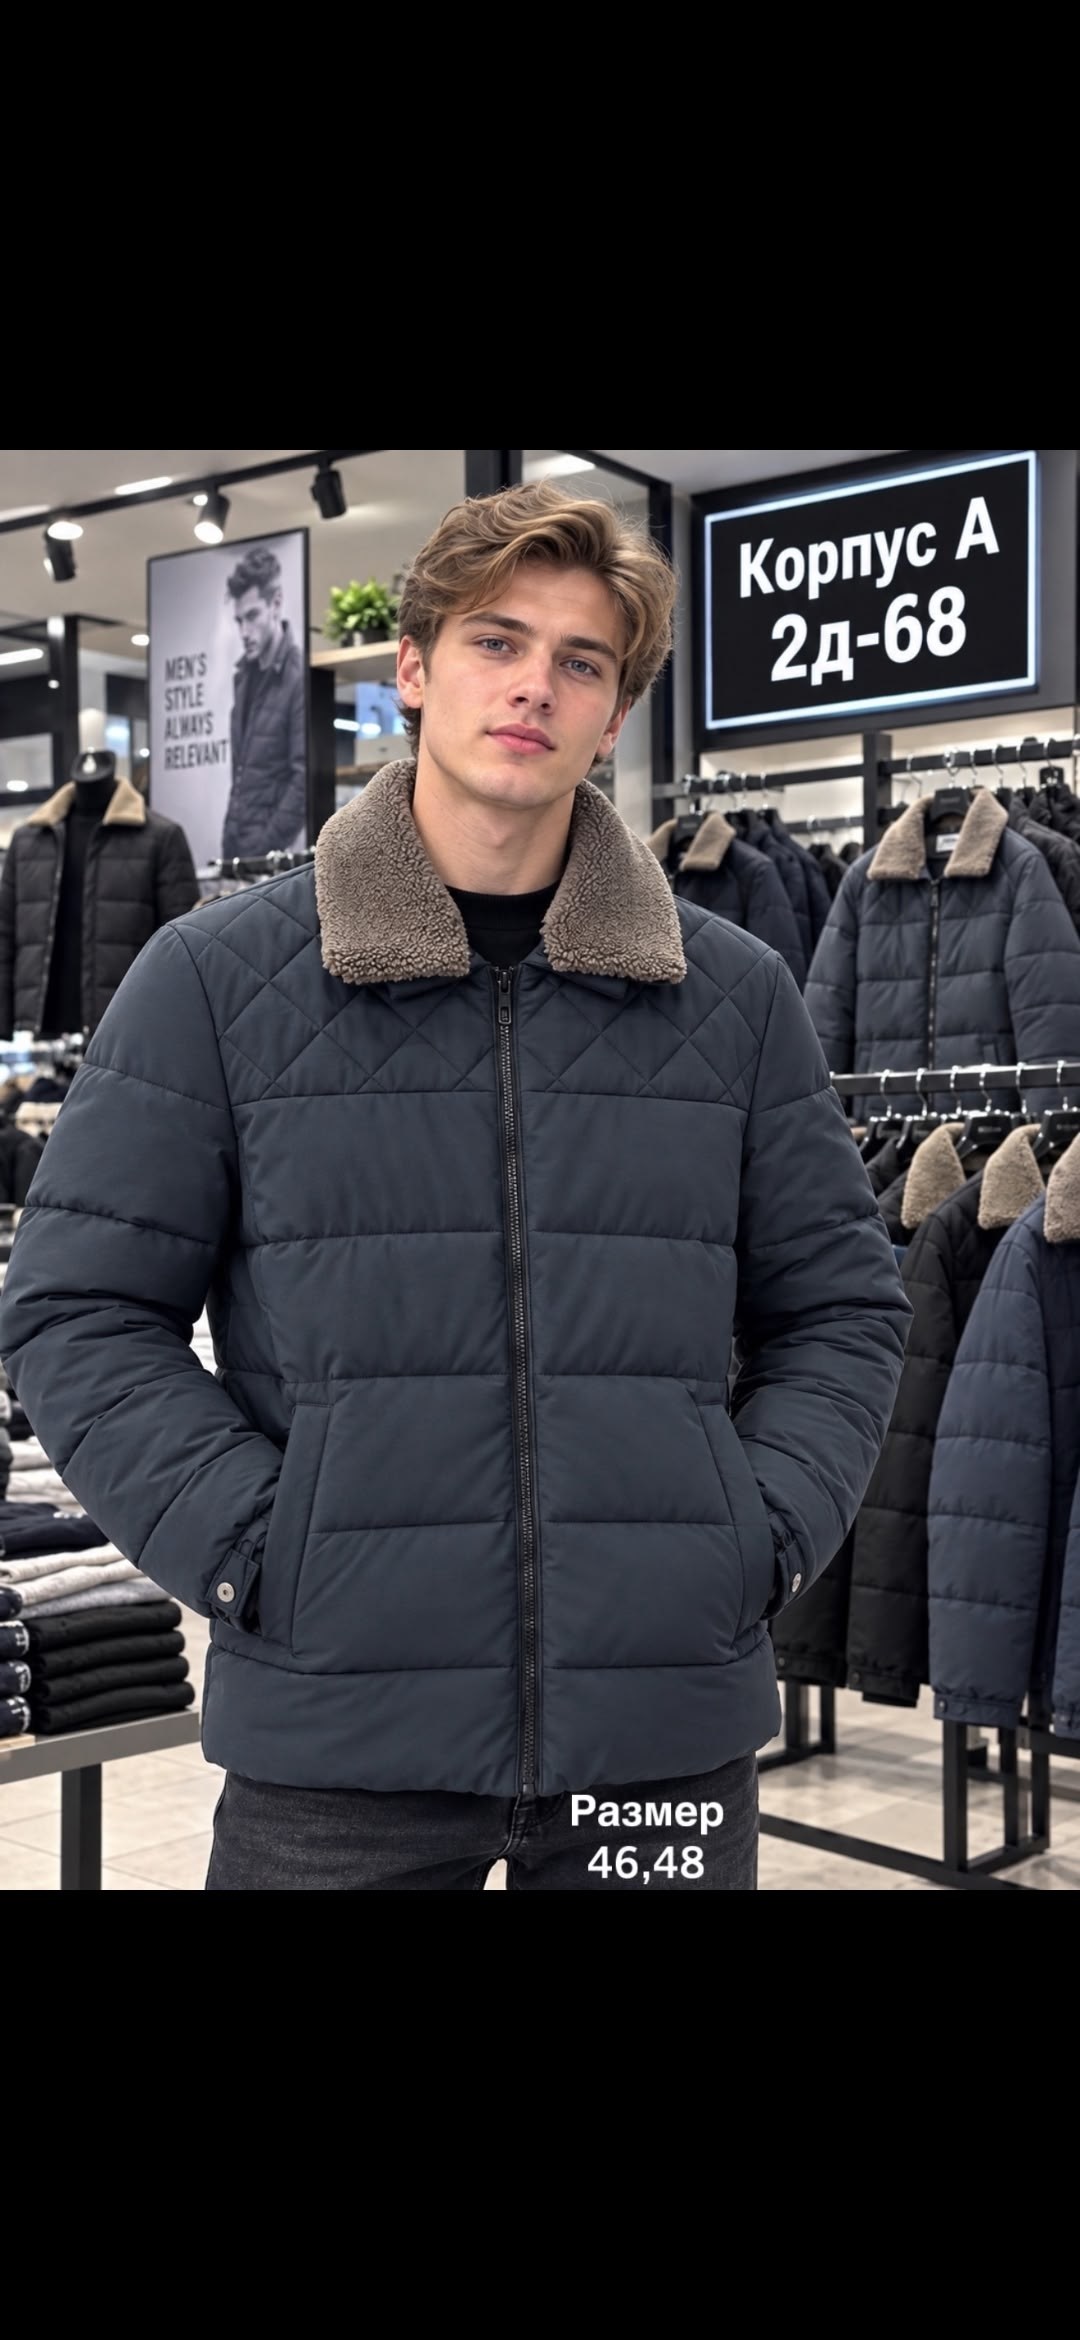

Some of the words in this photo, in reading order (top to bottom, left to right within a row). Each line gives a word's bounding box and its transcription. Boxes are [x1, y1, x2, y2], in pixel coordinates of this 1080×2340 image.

[740, 522, 937, 600] Корпус
[954, 496, 1000, 560] А
[770, 585, 967, 686] 2д-68
[165, 653, 206, 681] MEN'S
[165, 683, 203, 711] STYLE
[165, 711, 213, 740] ALWAYS
[165, 739, 227, 769] RELEVANT
